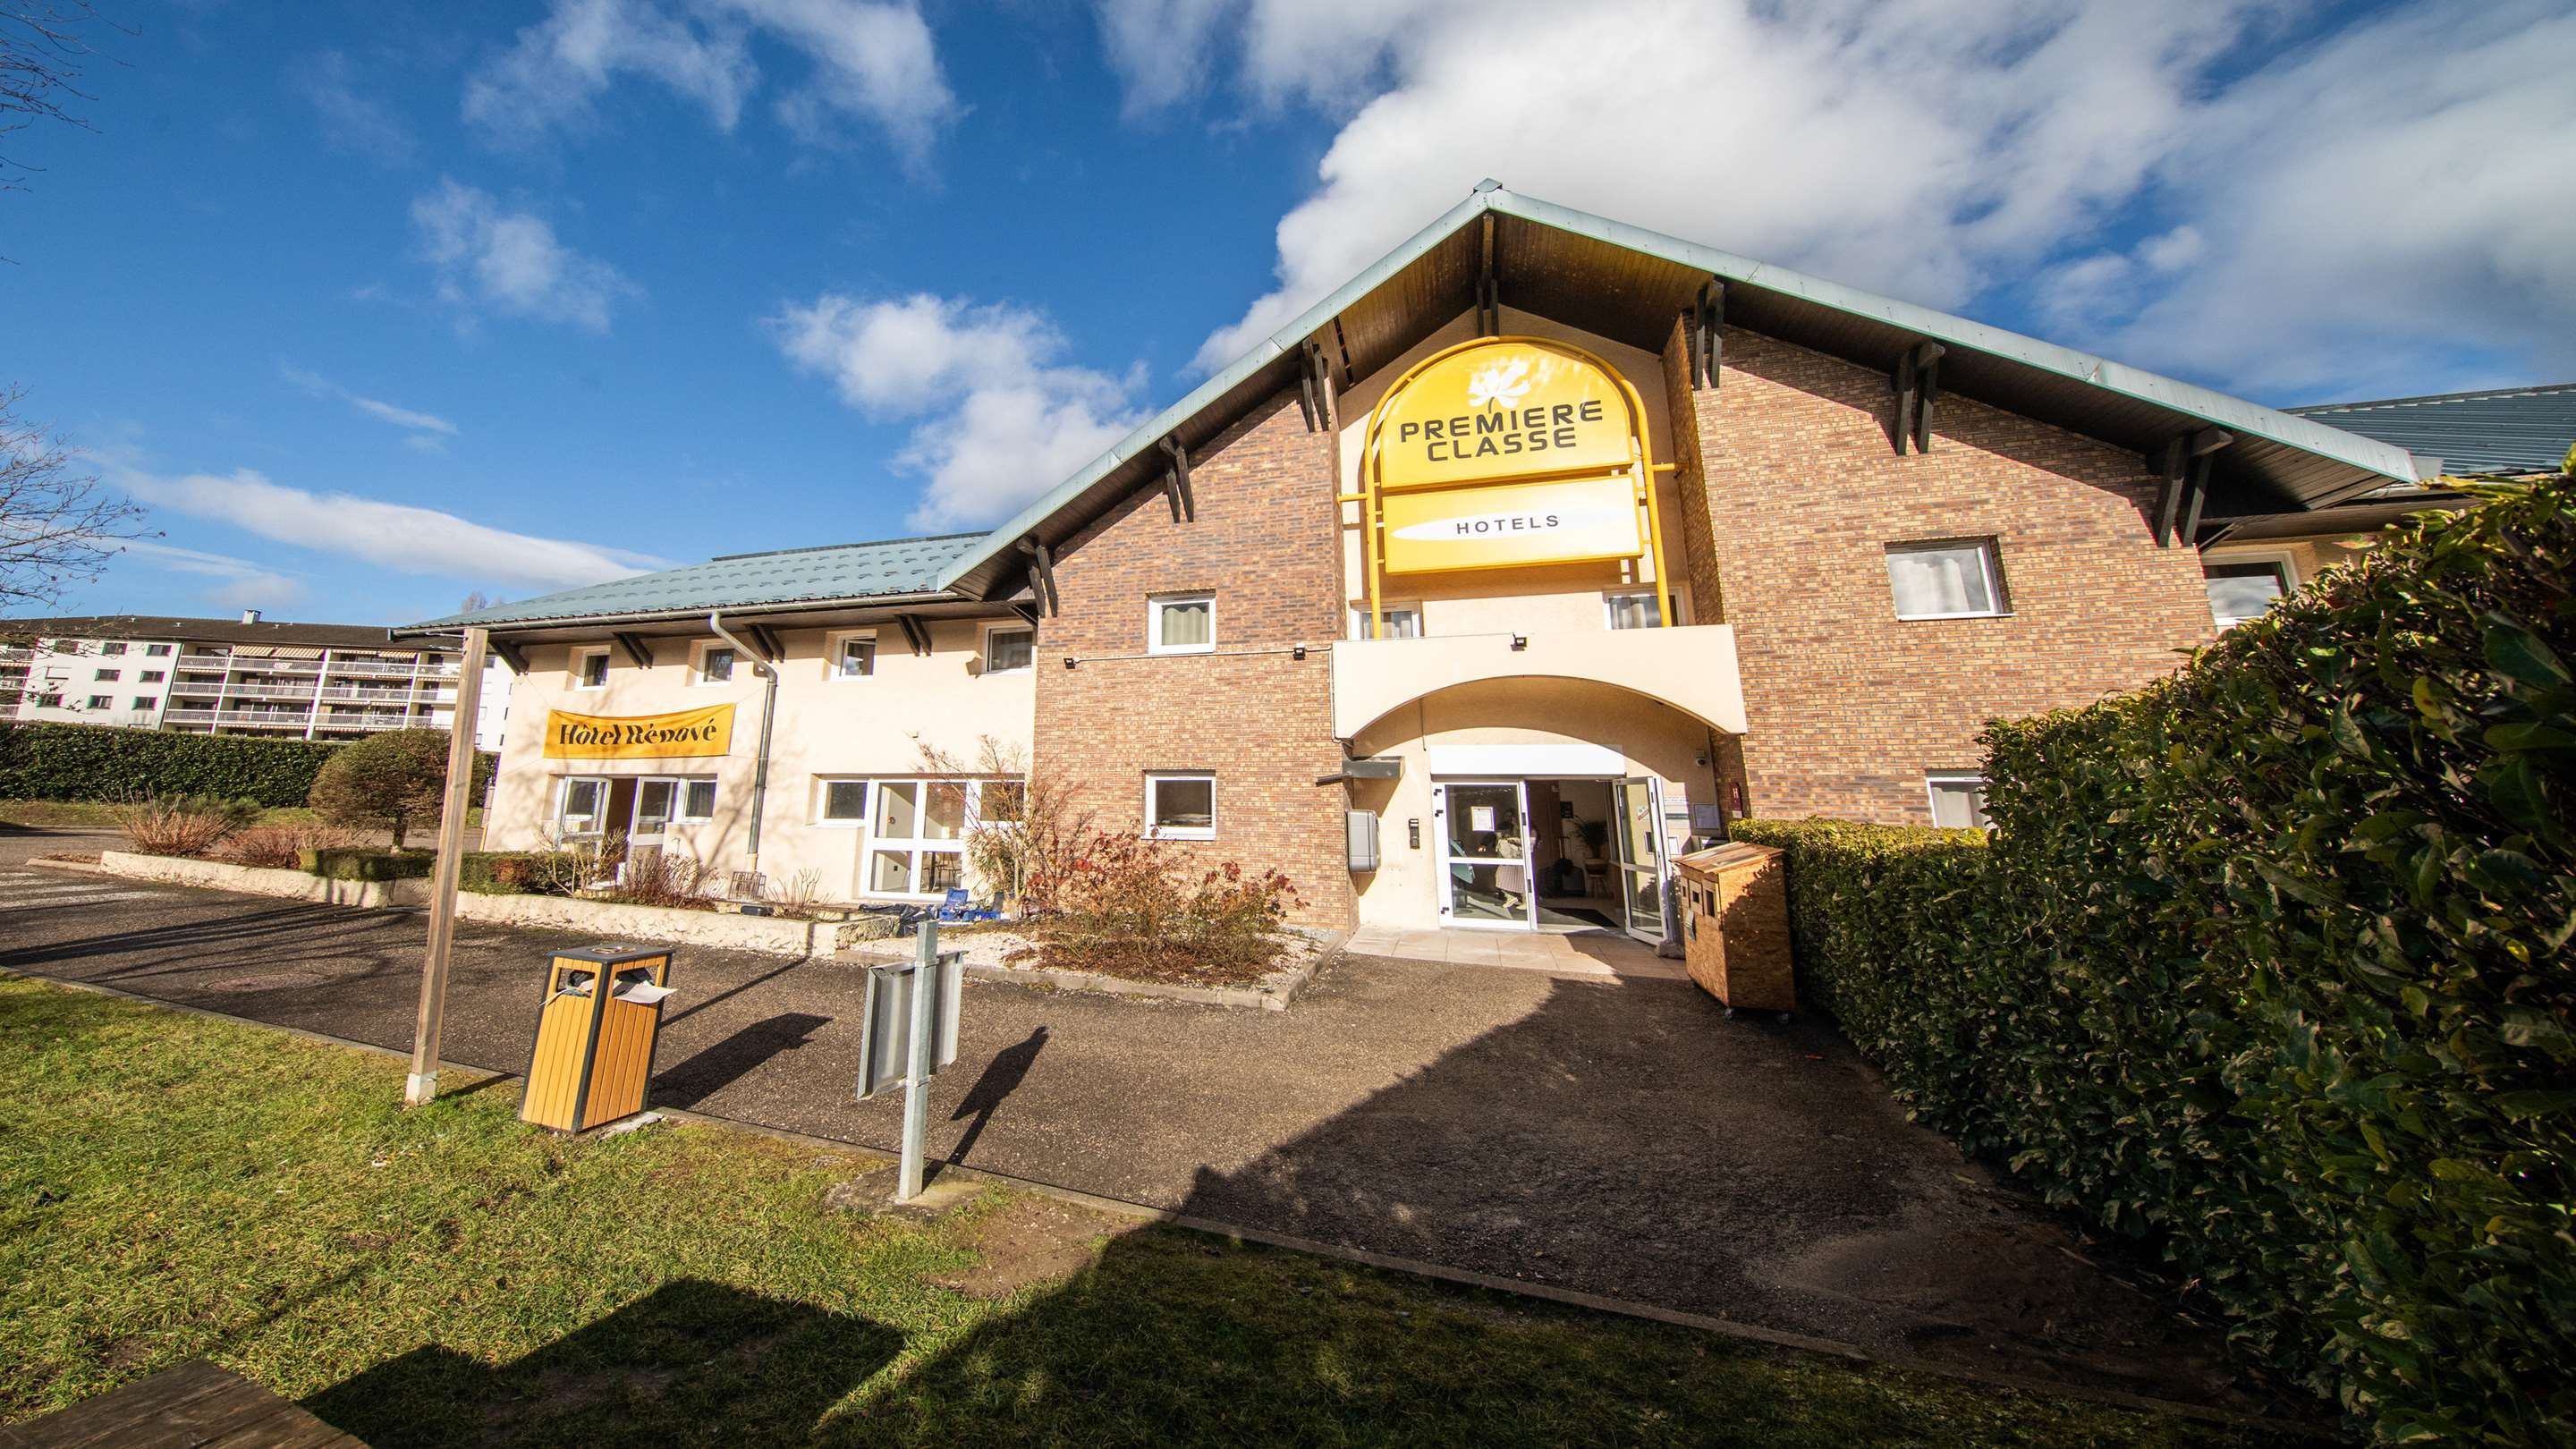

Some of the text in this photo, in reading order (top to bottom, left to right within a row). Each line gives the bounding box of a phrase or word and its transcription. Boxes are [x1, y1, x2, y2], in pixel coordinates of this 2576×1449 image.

[1401, 400, 1603, 443] PREMIERE
[1428, 427, 1576, 462] CLASSE
[1456, 514, 1559, 535] HOTELS
[559, 718, 716, 745] Hôtel Rénové
